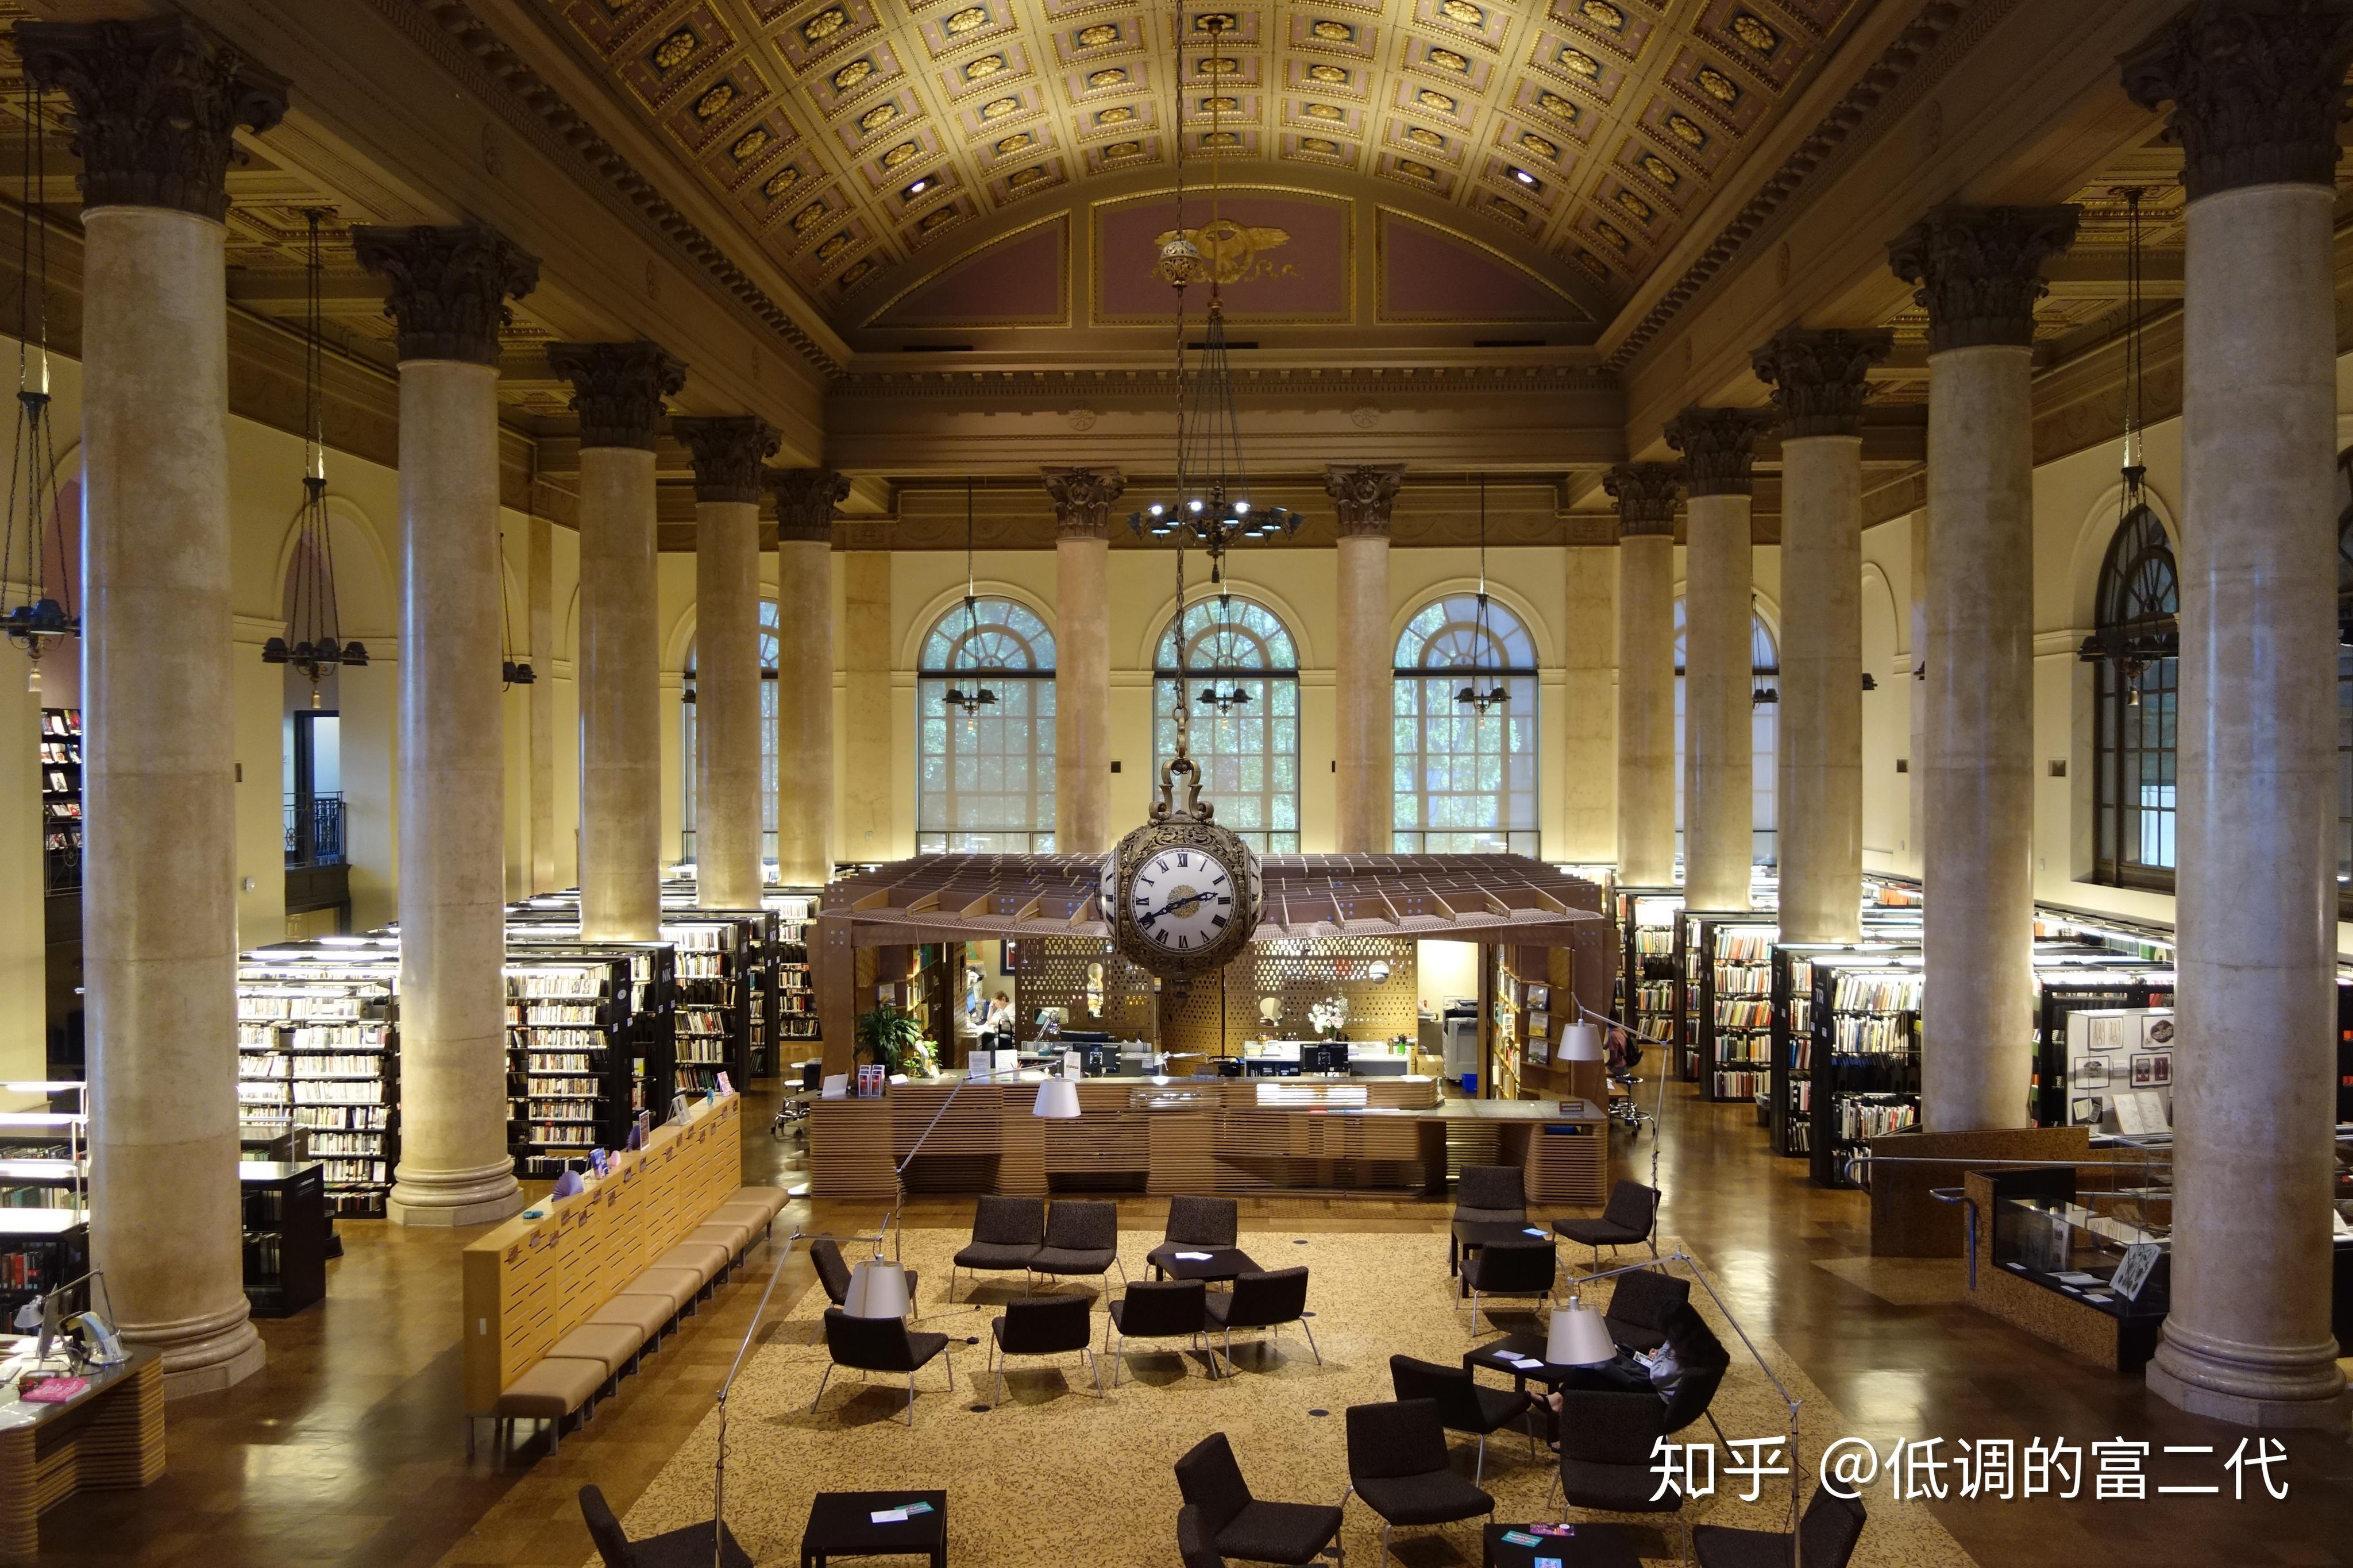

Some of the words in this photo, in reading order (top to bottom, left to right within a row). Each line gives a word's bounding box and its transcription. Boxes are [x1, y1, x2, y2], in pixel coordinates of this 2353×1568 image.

[1155, 858, 1170, 874] XI
[1177, 853, 1188, 867] XII
[1199, 859, 1208, 872] I
[1140, 875, 1155, 887] X
[1212, 874, 1225, 886] II
[1135, 897, 1149, 906] IX
[1218, 896, 1231, 905] III
[1155, 928, 1169, 945] VII
[1179, 935, 1189, 948] VI
[1200, 930, 1210, 943] V
[662, 968, 672, 983] NK
[1815, 987, 1824, 1004] TR
